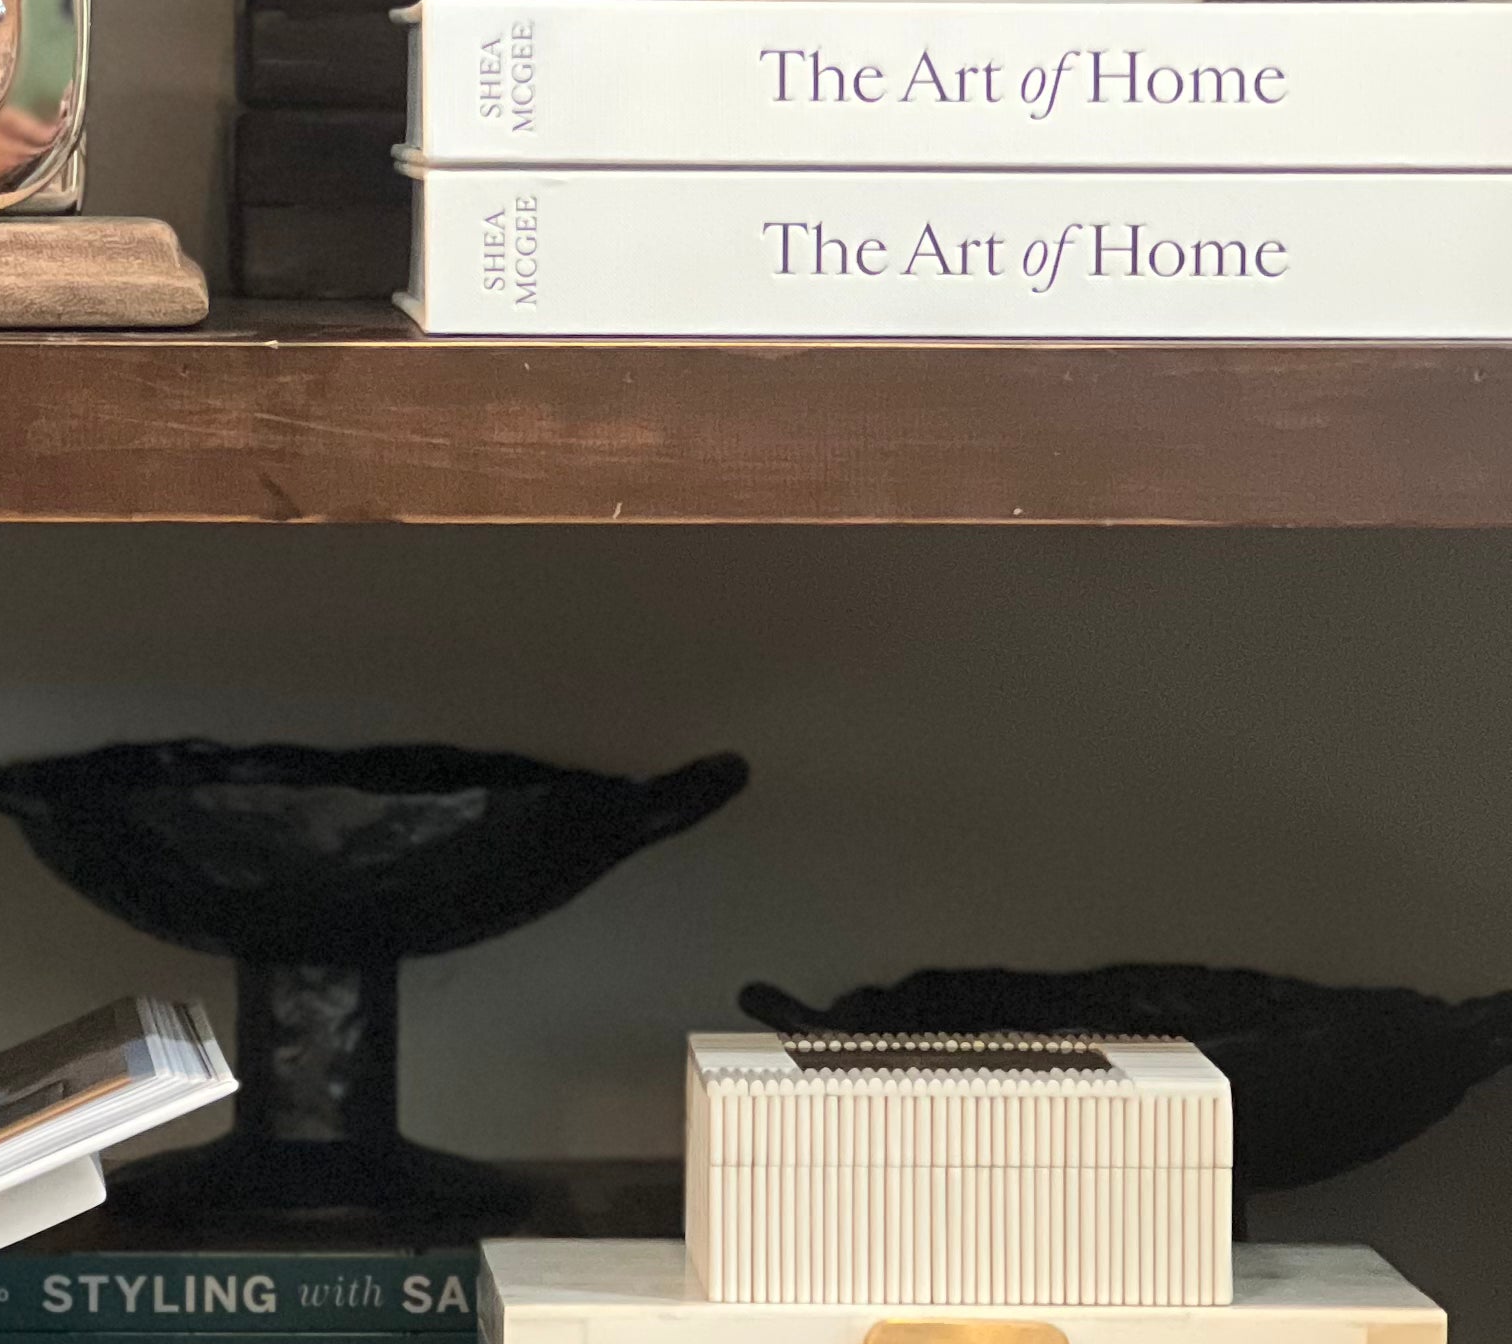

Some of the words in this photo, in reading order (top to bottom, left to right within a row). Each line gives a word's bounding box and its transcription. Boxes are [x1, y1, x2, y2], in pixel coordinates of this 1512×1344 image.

[479, 32, 502, 119] SHEA
[510, 19, 535, 133] MCGEE
[759, 45, 887, 104] The
[897, 45, 1006, 105] Art
[1019, 49, 1082, 121] of
[1086, 48, 1288, 105] Home
[482, 207, 506, 292] SHEA
[514, 195, 538, 307] MCGEE
[762, 219, 889, 277] The
[898, 219, 1007, 278] Art
[1021, 222, 1084, 295] of
[1087, 222, 1290, 279] Home
[42, 1274, 278, 1315] STYLING
[298, 1274, 383, 1307] with
[402, 1275, 471, 1314] SA
